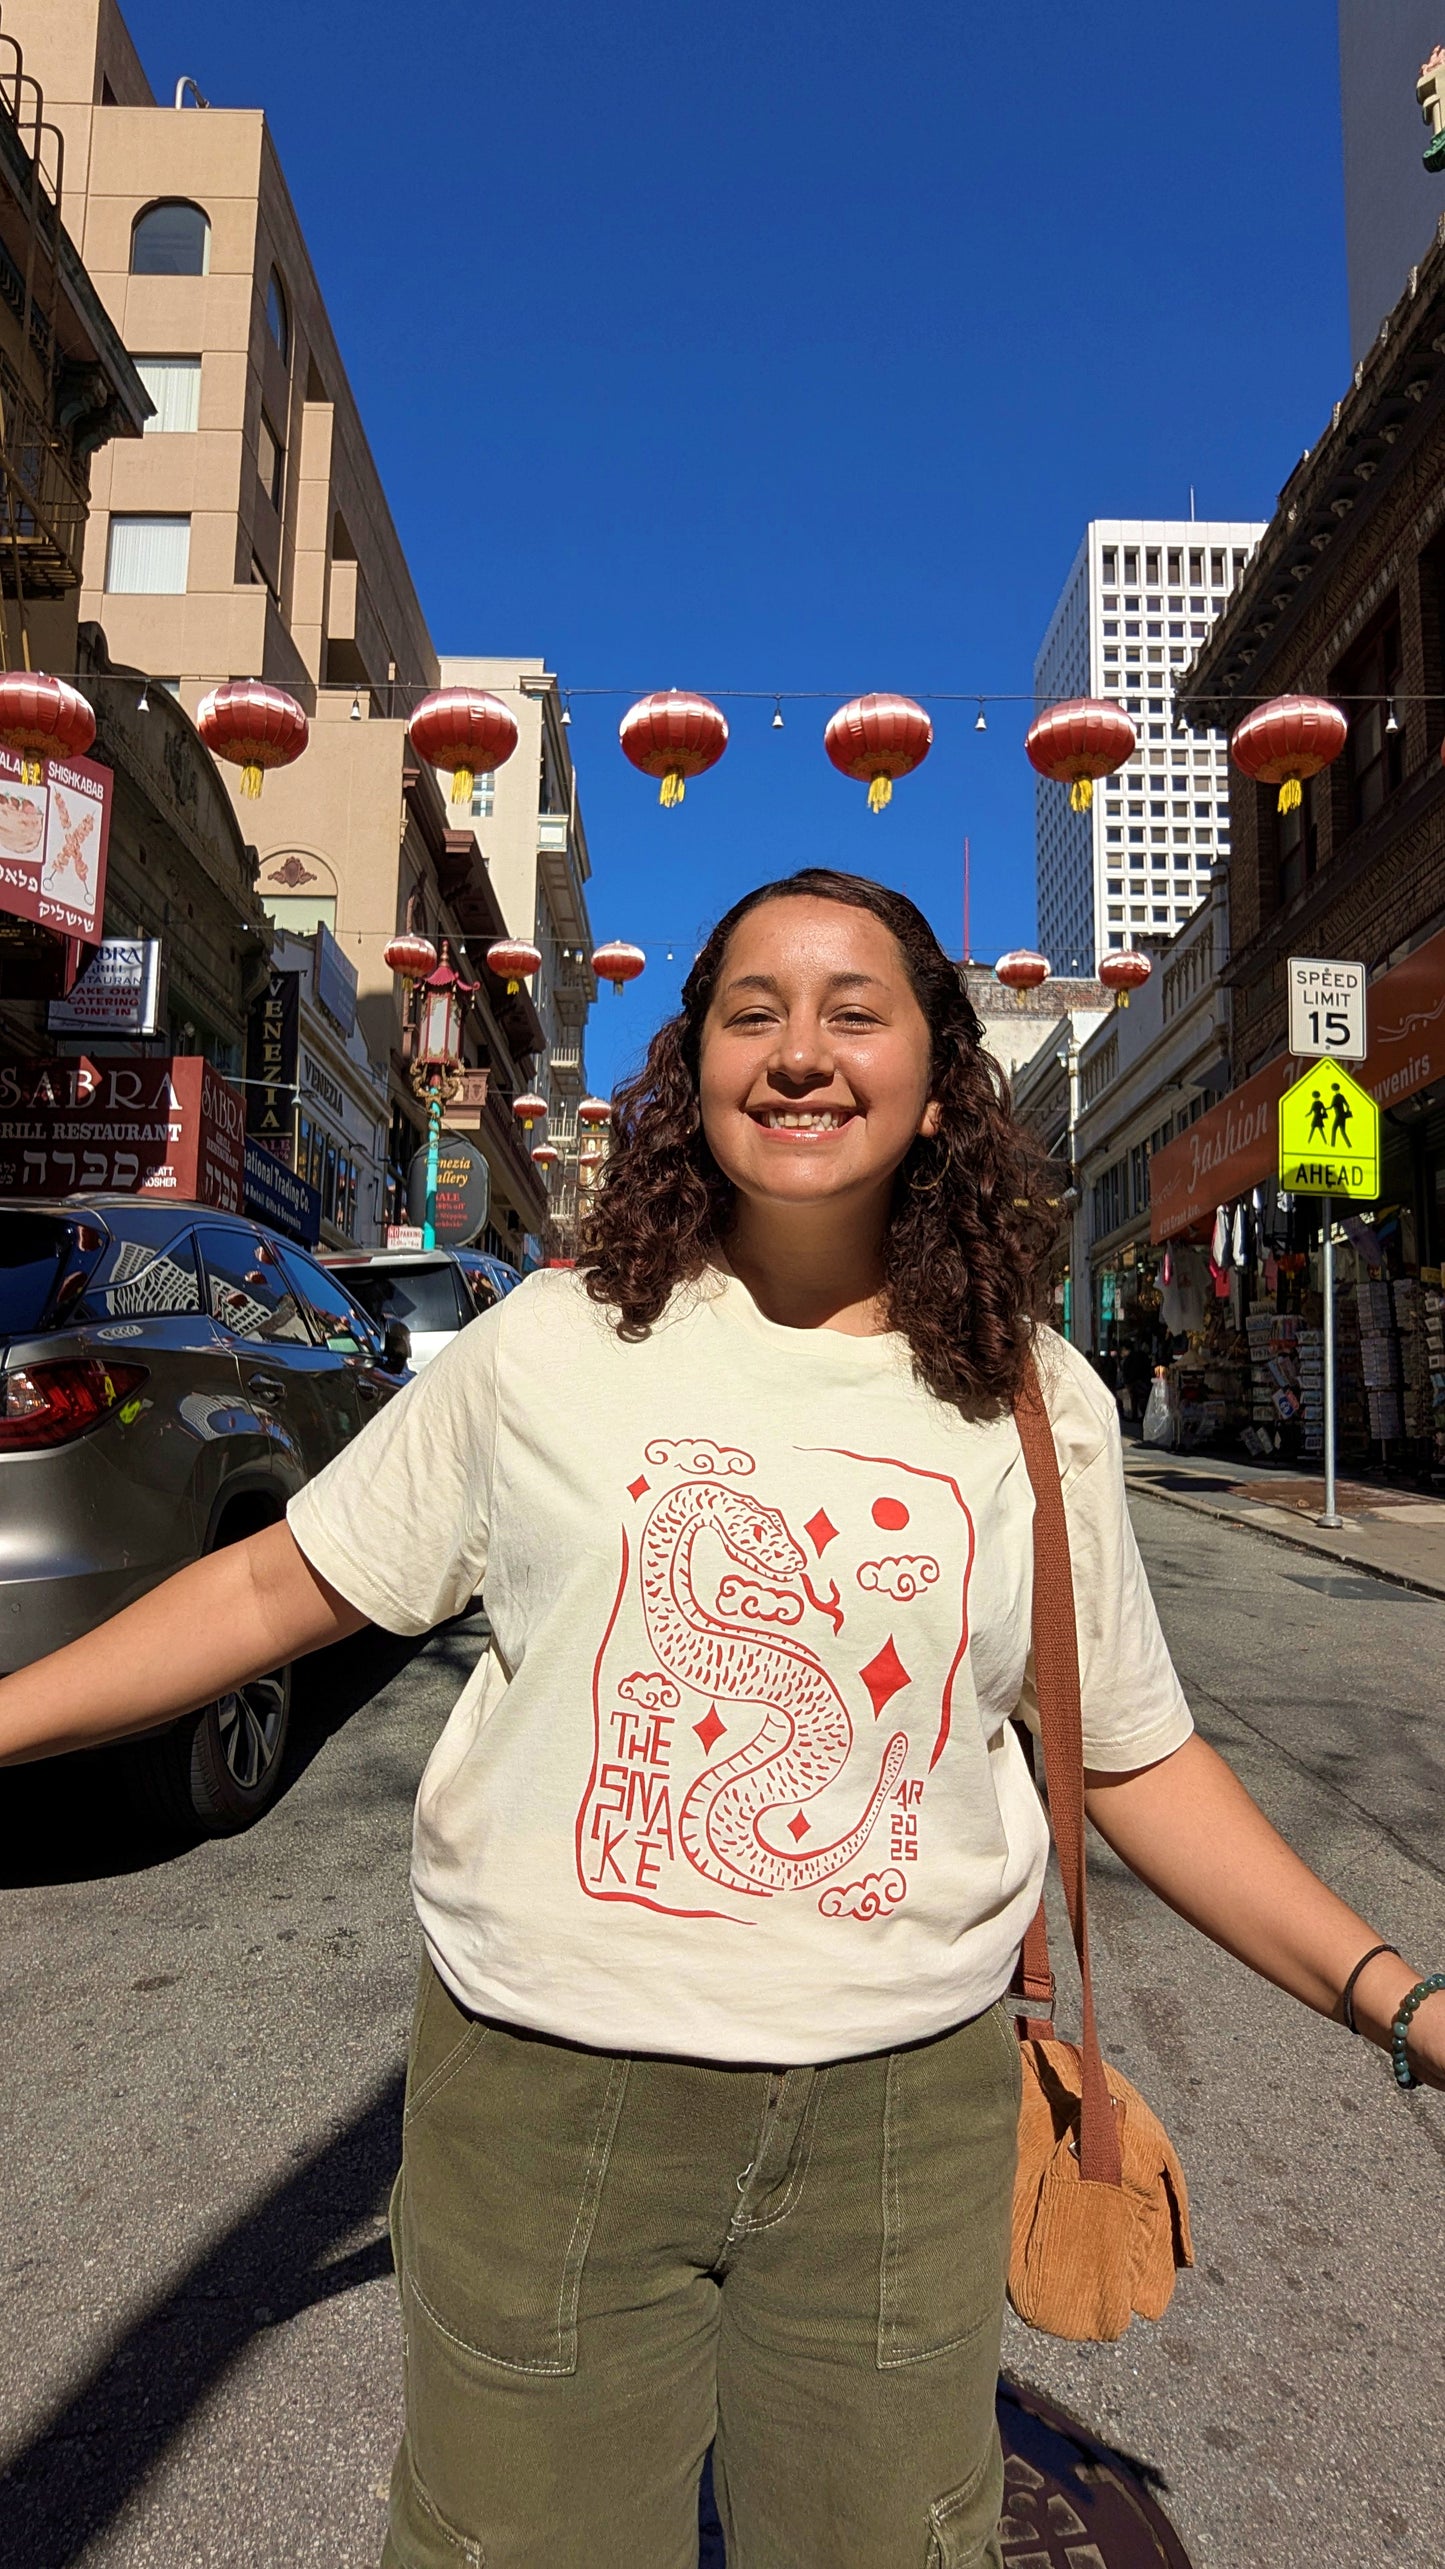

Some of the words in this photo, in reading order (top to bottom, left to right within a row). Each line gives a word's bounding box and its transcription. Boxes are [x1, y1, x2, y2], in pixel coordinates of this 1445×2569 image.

[48, 761, 104, 800] SHISHKABAB
[38, 901, 94, 933] שישליק
[1297, 970, 1358, 989] SPEED
[67, 996, 139, 1007] CATERING
[75, 987, 104, 996] AKE
[110, 988, 141, 997] OUT
[1303, 990, 1351, 1008] LIMIT
[74, 1007, 109, 1016] DINE
[116, 1007, 131, 1016] IN
[1308, 1011, 1351, 1046] 15
[259, 978, 284, 1129] VENEZIA
[0, 1066, 183, 1110] SABRA
[304, 1054, 344, 1118] VENEZIA
[202, 1075, 245, 1147] SABRA
[0, 1122, 46, 1140] RILL
[52, 1123, 182, 1142] RESTAURANT
[260, 1139, 291, 1151] ALE
[1187, 1100, 1268, 1194] Fashion
[146, 1166, 174, 1177] GLATT
[424, 1157, 471, 1170] nezia
[142, 1177, 177, 1187] KOSHER
[427, 1171, 468, 1187] allery
[1296, 1163, 1364, 1187] AHEAD
[274, 1167, 300, 1211] Trading
[300, 1187, 310, 1214] Co.
[610, 1711, 675, 1766] THE
